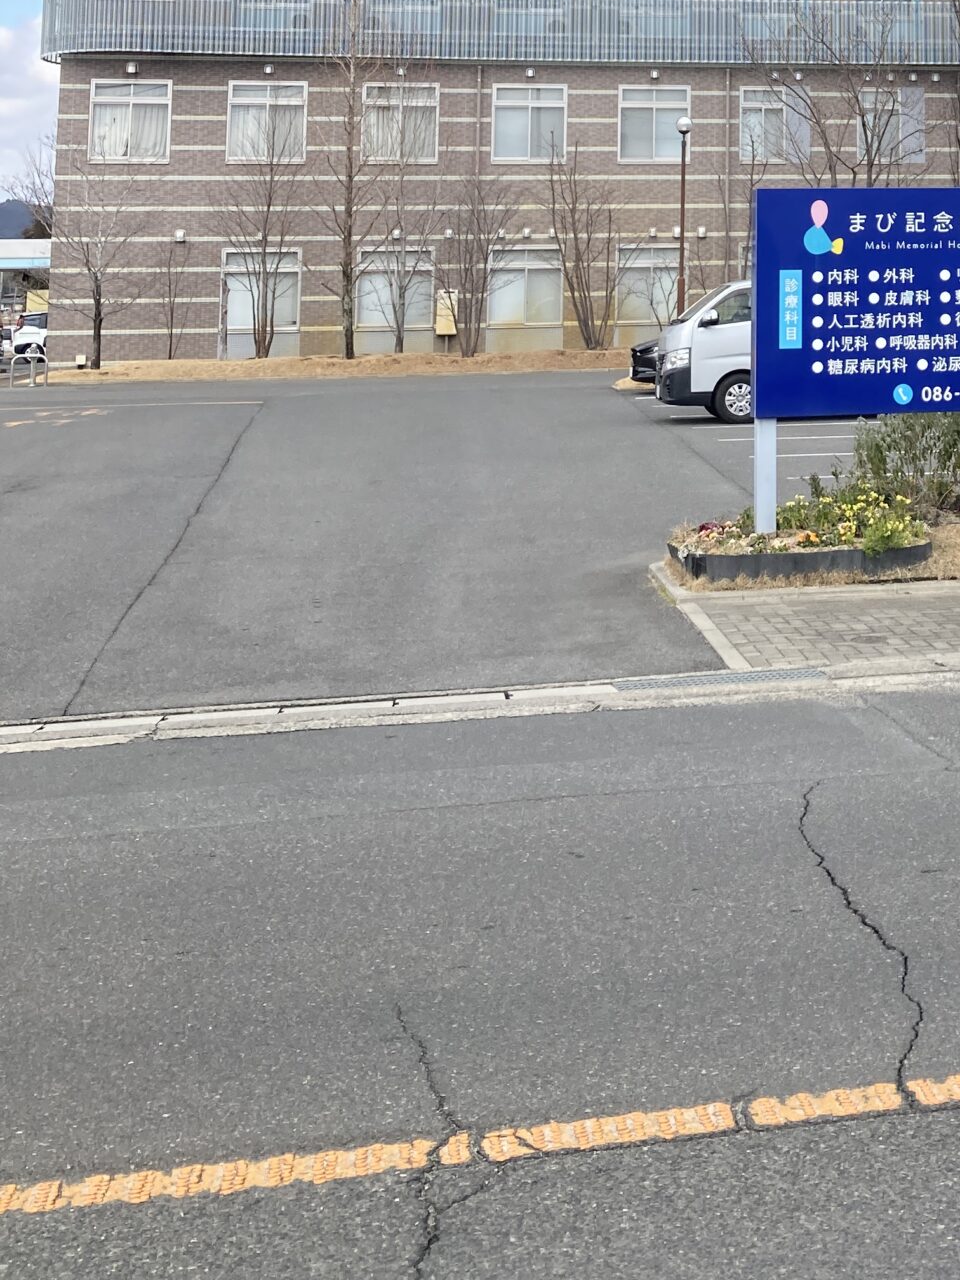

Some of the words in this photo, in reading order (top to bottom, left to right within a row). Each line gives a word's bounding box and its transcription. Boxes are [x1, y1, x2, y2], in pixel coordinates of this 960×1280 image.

[864, 241, 891, 250] Mabi
[895, 239, 943, 250] Memorial
[827, 268, 860, 285] 内科
[883, 267, 915, 284] 外科
[827, 290, 860, 307] 眼科
[884, 289, 931, 306] 皮膚科
[784, 278, 799, 341] 診療科目
[827, 312, 924, 329] 人工透析内科
[826, 335, 869, 352] 小児科
[889, 333, 958, 351] 呼吸器内科
[827, 357, 908, 375] 糖尿病内科
